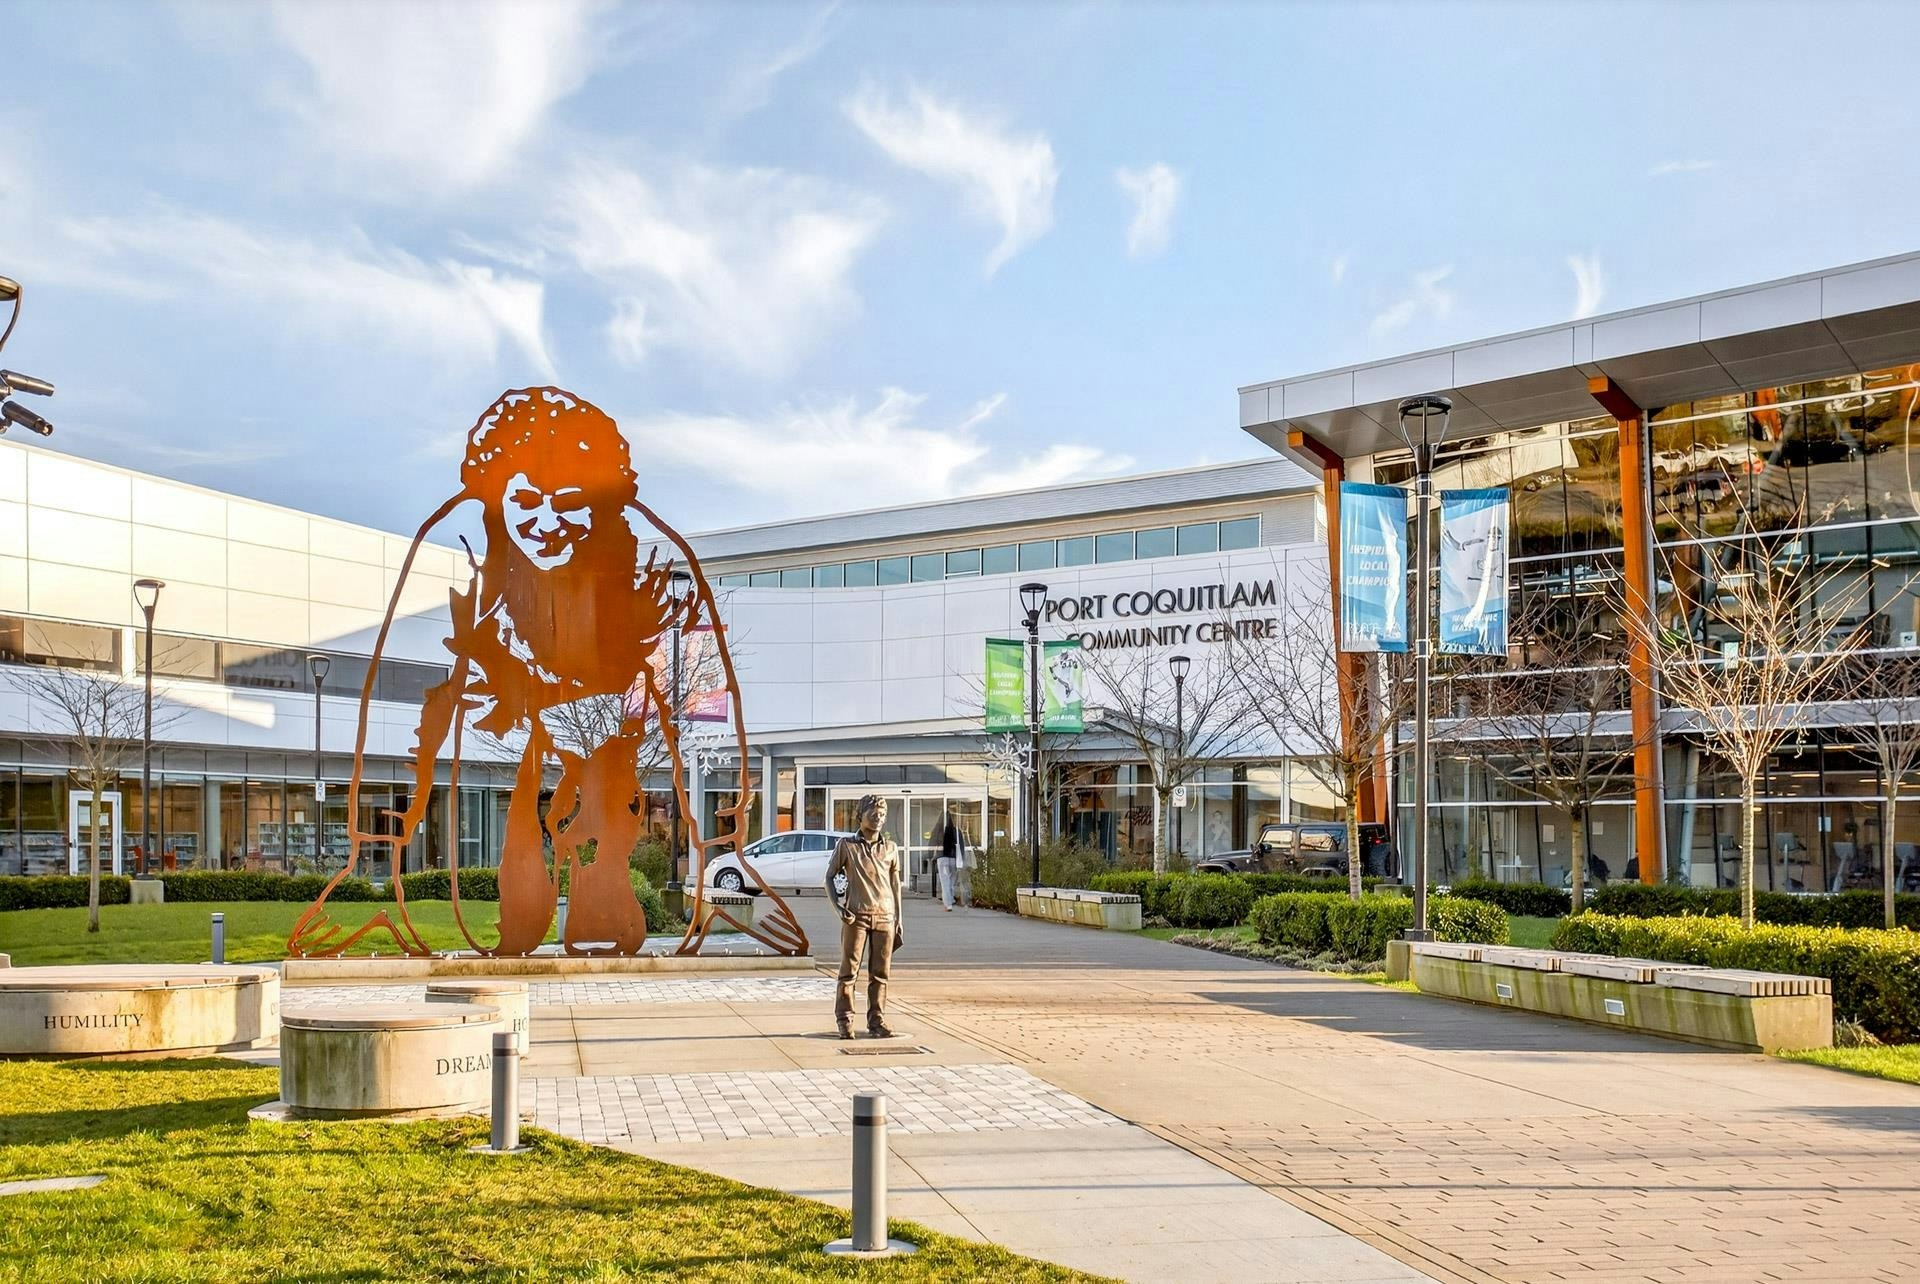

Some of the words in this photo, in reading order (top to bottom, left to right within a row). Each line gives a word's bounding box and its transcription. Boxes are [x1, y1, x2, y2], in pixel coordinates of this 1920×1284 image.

[1045, 594, 1108, 623] PORT
[1112, 579, 1277, 617] COQUITLAM
[1196, 617, 1278, 643] CENTRE
[43, 1013, 144, 1031] HUMILITY
